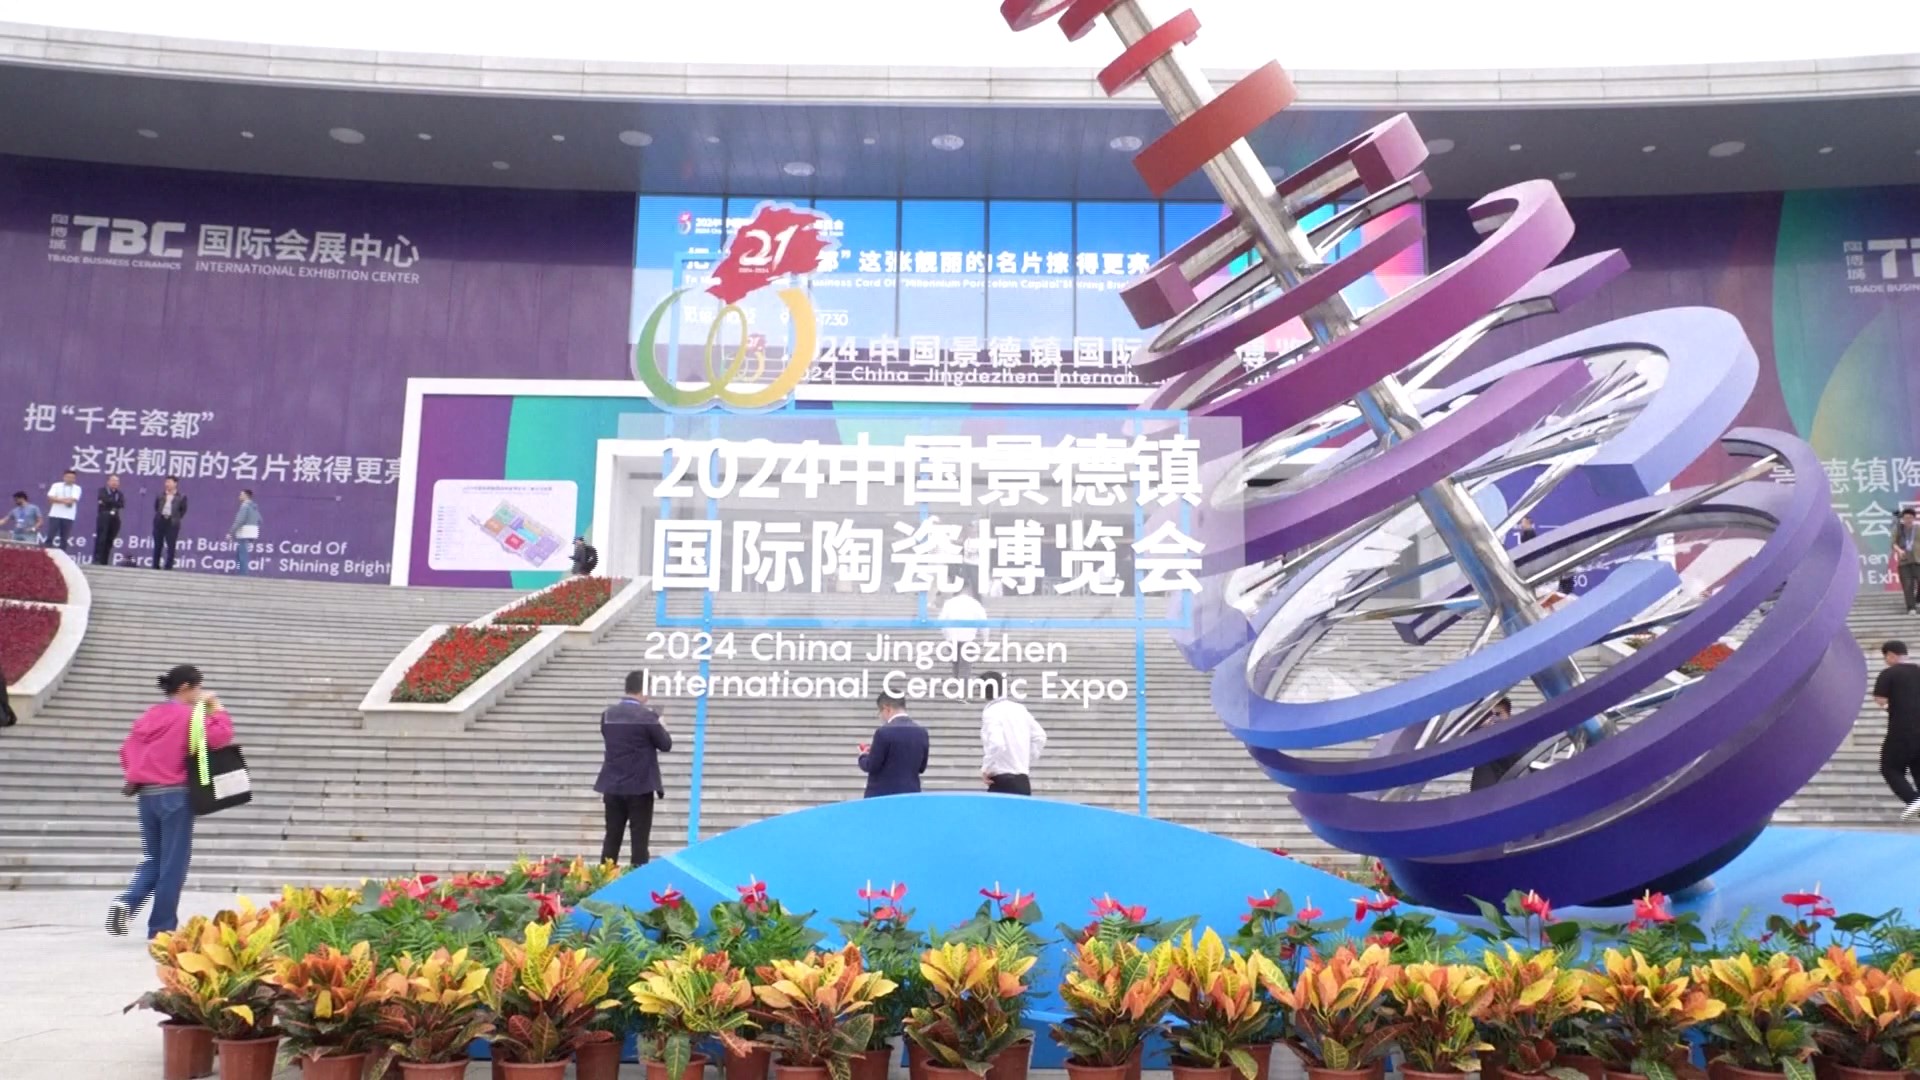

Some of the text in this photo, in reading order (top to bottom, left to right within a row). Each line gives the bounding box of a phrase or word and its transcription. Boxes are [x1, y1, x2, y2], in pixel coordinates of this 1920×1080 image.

[72, 214, 186, 259] TBC
[197, 223, 419, 268] 国际会展中心
[739, 224, 800, 272] 21
[47, 253, 182, 271] TRADE BUSINESS CERAMICS
[195, 261, 420, 284] INTERNATIONAL EXHIBITION CENTER
[1867, 238, 1920, 279] T
[851, 366, 909, 382] China
[924, 367, 1041, 387] Jingdezhen
[24, 402, 214, 439] 把“千年瓷都”
[652, 431, 1203, 507] 2024中国景德镇
[279, 540, 320, 555] Card
[325, 541, 348, 555] Of
[652, 516, 1205, 597] 国际陶瓷博览会
[279, 558, 339, 577] Shining
[643, 630, 1067, 670] 2024 China Jingdezhen
[641, 669, 1129, 708] International Ceramic Expo
